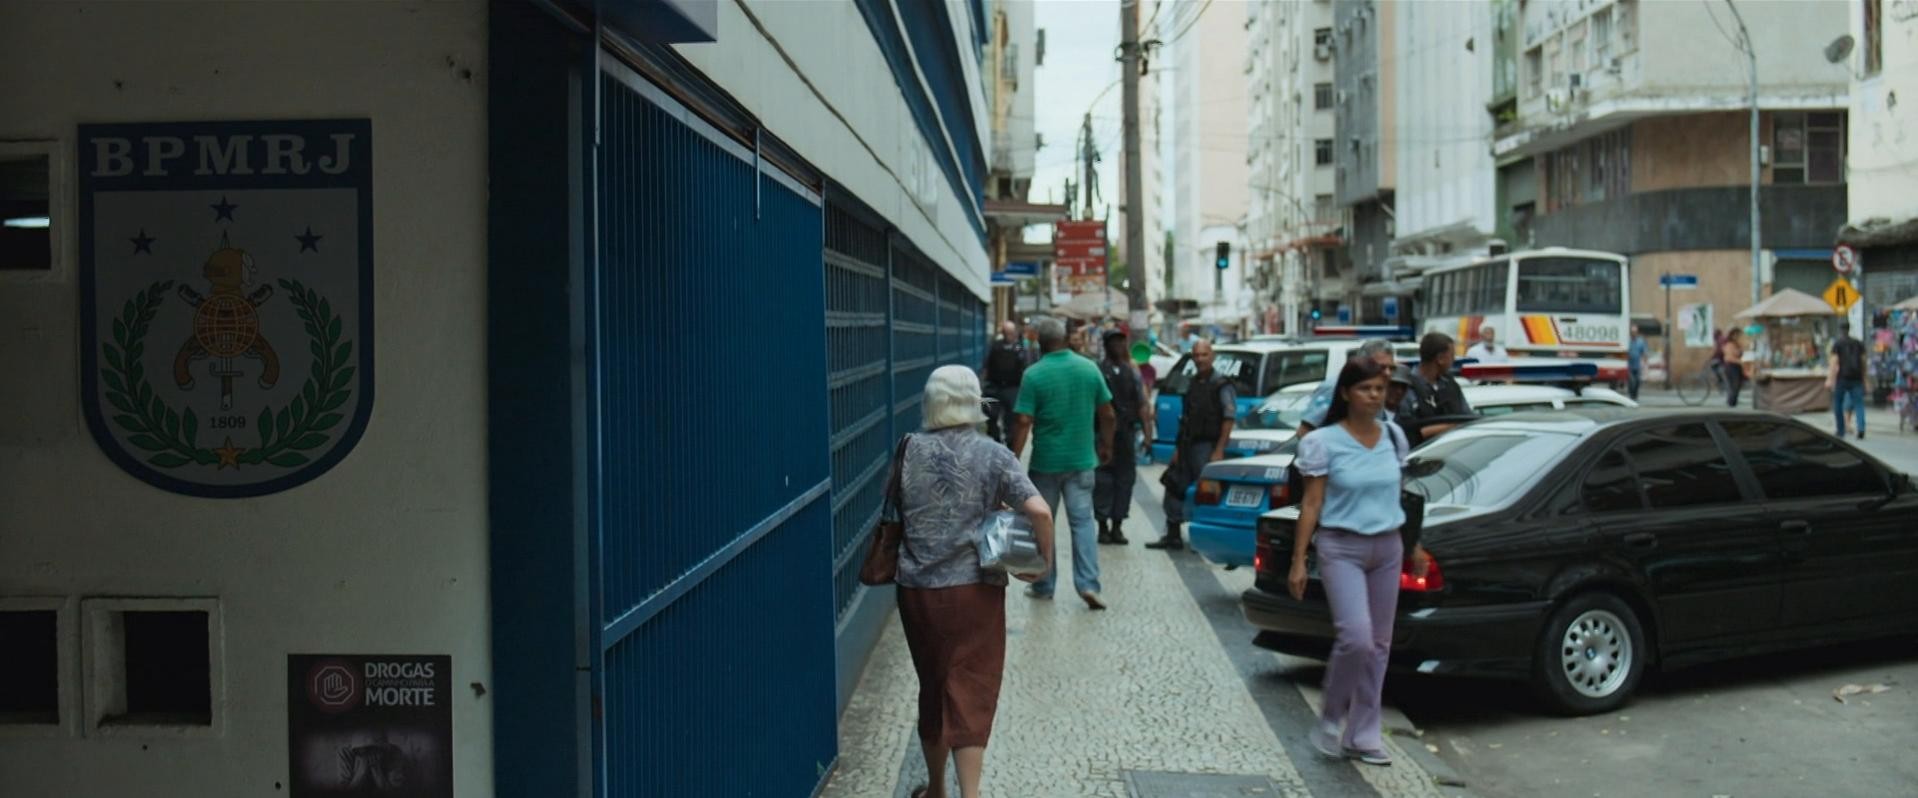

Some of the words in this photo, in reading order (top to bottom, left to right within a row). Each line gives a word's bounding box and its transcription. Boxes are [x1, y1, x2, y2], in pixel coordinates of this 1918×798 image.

[90, 133, 356, 177] BPMRJ
[1563, 325, 1619, 340] 48098
[209, 415, 246, 429] 1809
[364, 662, 435, 679] DROGAS
[365, 687, 435, 706] MORTE
